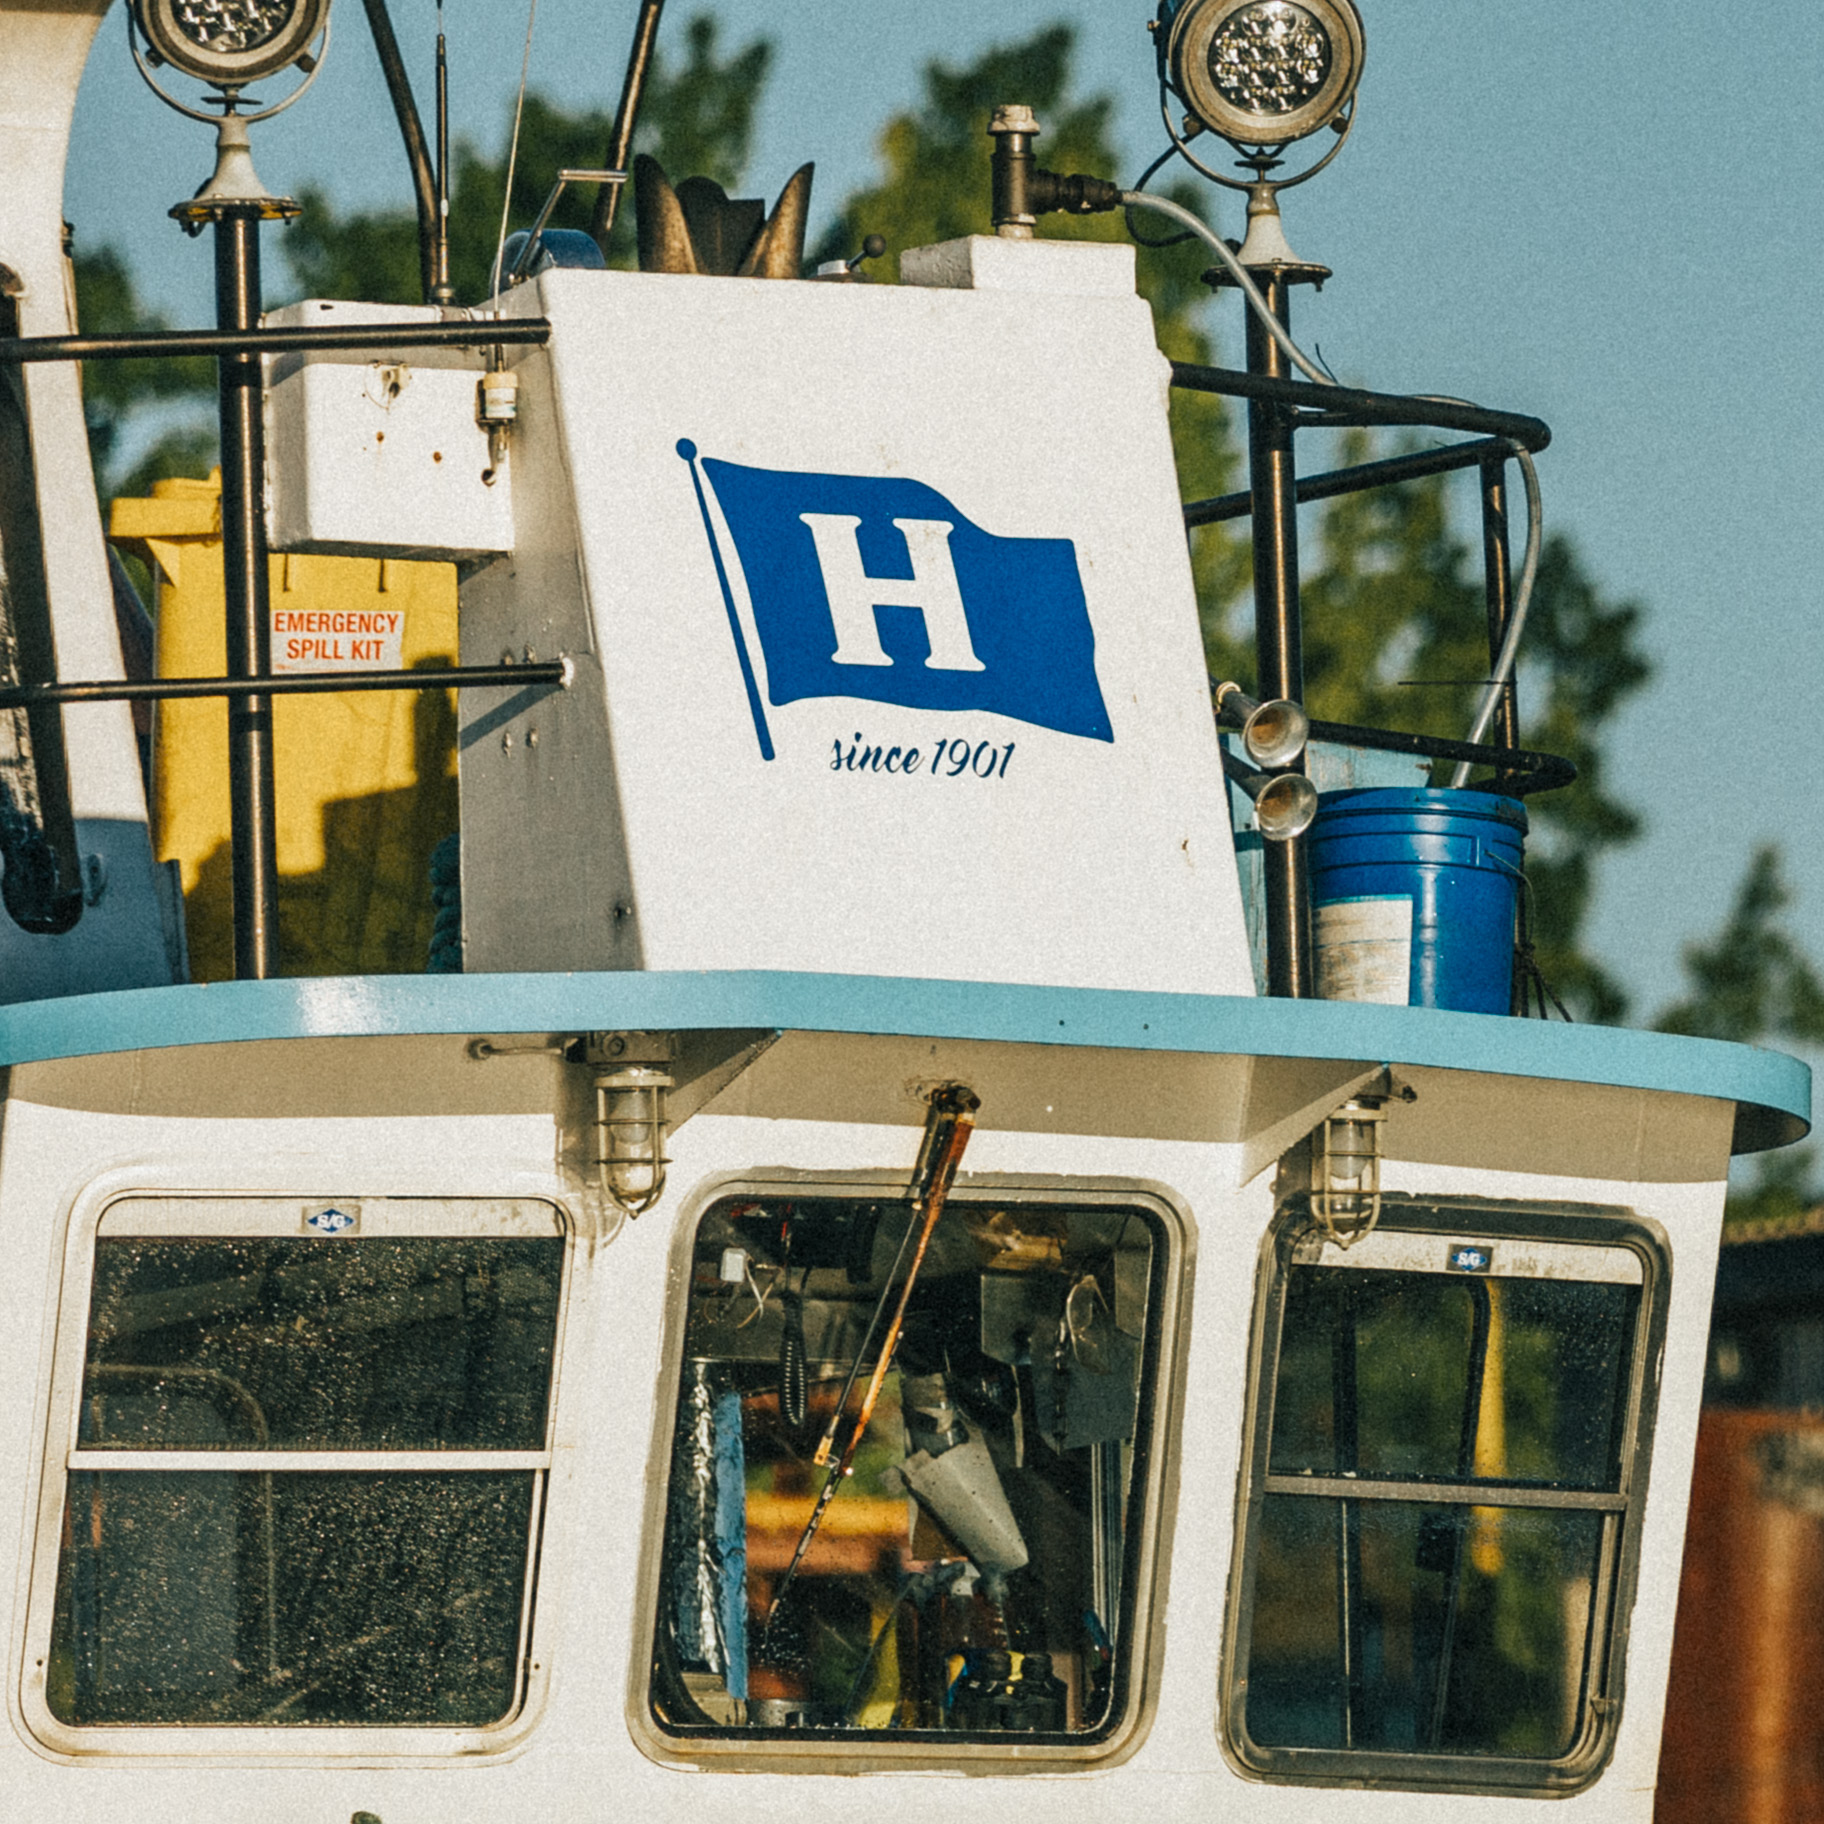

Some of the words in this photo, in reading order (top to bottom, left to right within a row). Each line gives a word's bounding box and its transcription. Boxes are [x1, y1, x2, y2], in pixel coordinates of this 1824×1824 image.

[800, 513, 986, 672] H
[274, 613, 399, 633] EMERGENCY
[287, 639, 344, 660] SPILL
[351, 640, 384, 660] KIT
[830, 731, 920, 775] since
[931, 738, 1016, 779] 1901
